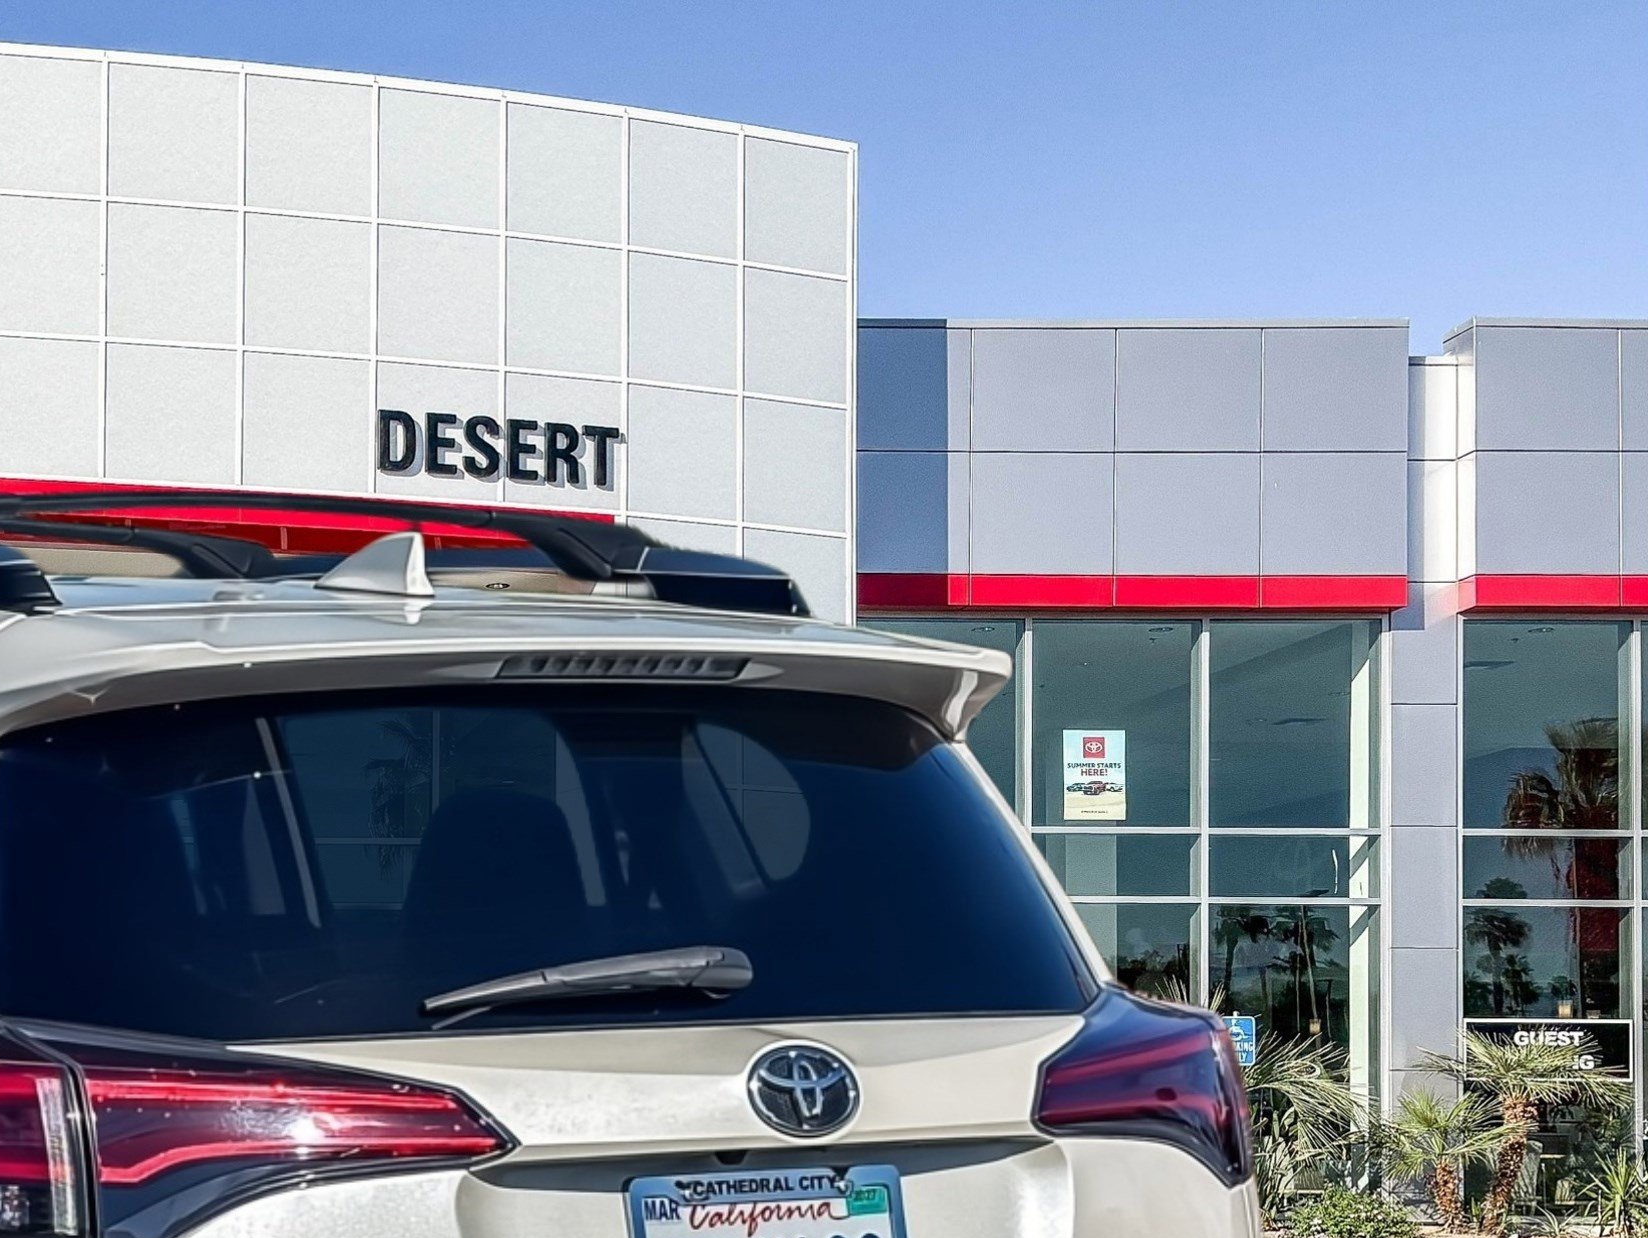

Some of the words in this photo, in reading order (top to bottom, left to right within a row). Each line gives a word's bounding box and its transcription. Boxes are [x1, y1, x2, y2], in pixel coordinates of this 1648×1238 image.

[377, 409, 620, 487] DESERT
[1080, 768, 1108, 776] HERE!
[1513, 1030, 1585, 1047] GUEST
[692, 1178, 795, 1197] CATHEDRAL
[798, 1175, 838, 1191] CITY
[643, 1199, 682, 1221] MAR
[688, 1201, 851, 1238] California
